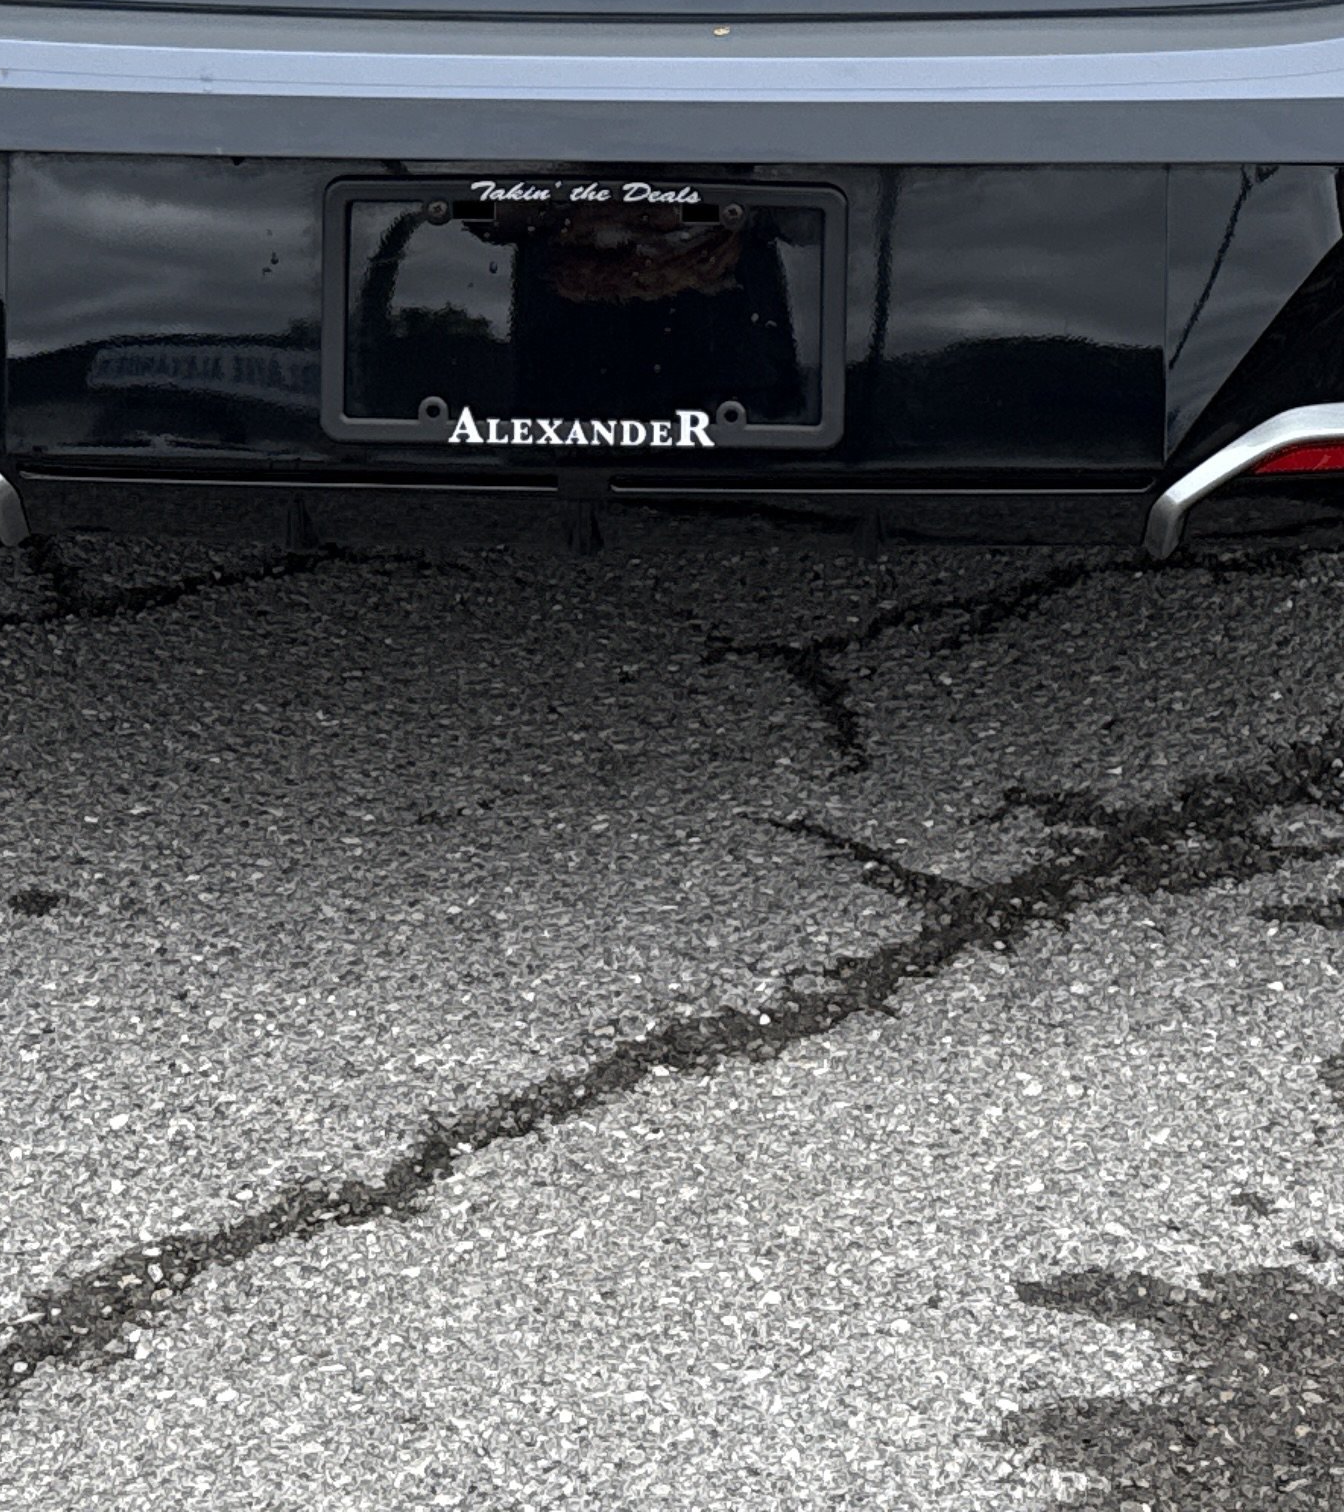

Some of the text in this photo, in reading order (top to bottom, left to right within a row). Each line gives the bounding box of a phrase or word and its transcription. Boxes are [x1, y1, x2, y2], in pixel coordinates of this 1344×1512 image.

[570, 182, 612, 202] the
[622, 181, 702, 204] Deals
[448, 406, 714, 448] ALEXANDER
